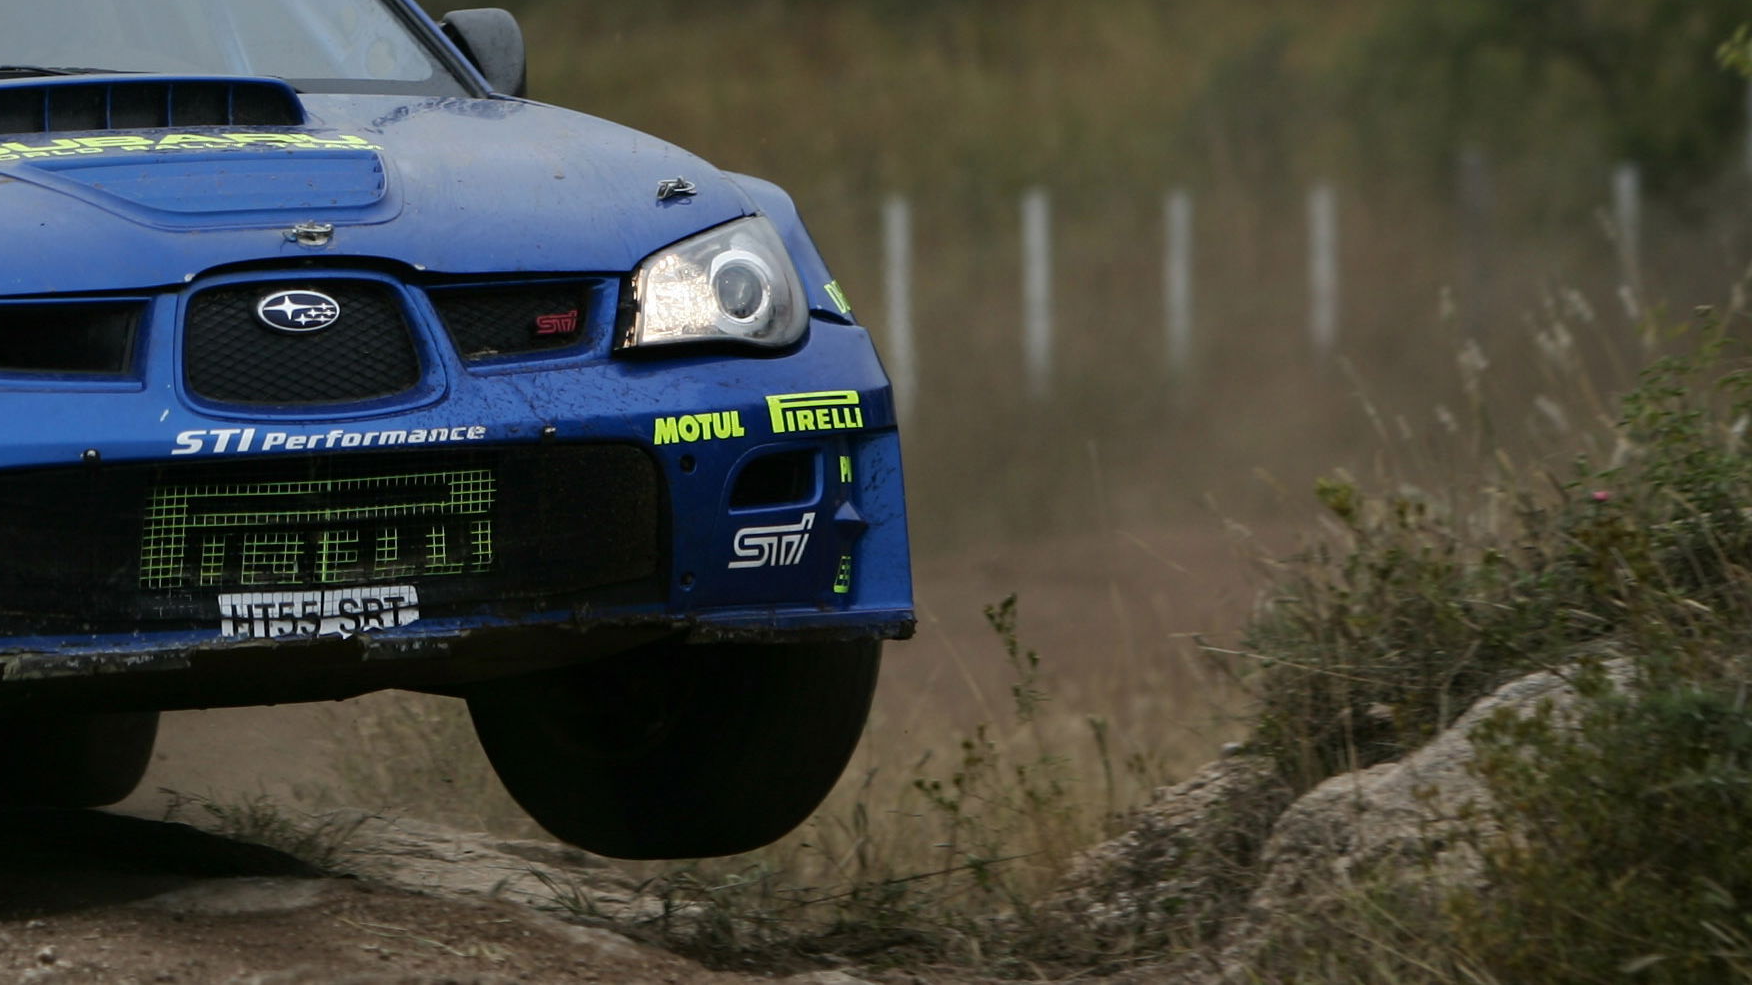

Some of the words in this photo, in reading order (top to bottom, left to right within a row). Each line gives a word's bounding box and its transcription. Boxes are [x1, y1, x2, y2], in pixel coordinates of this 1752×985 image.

[654, 410, 745, 446] MOTUL
[765, 390, 864, 434] PIRELLI
[171, 428, 256, 455] STI
[262, 425, 487, 452] Performance
